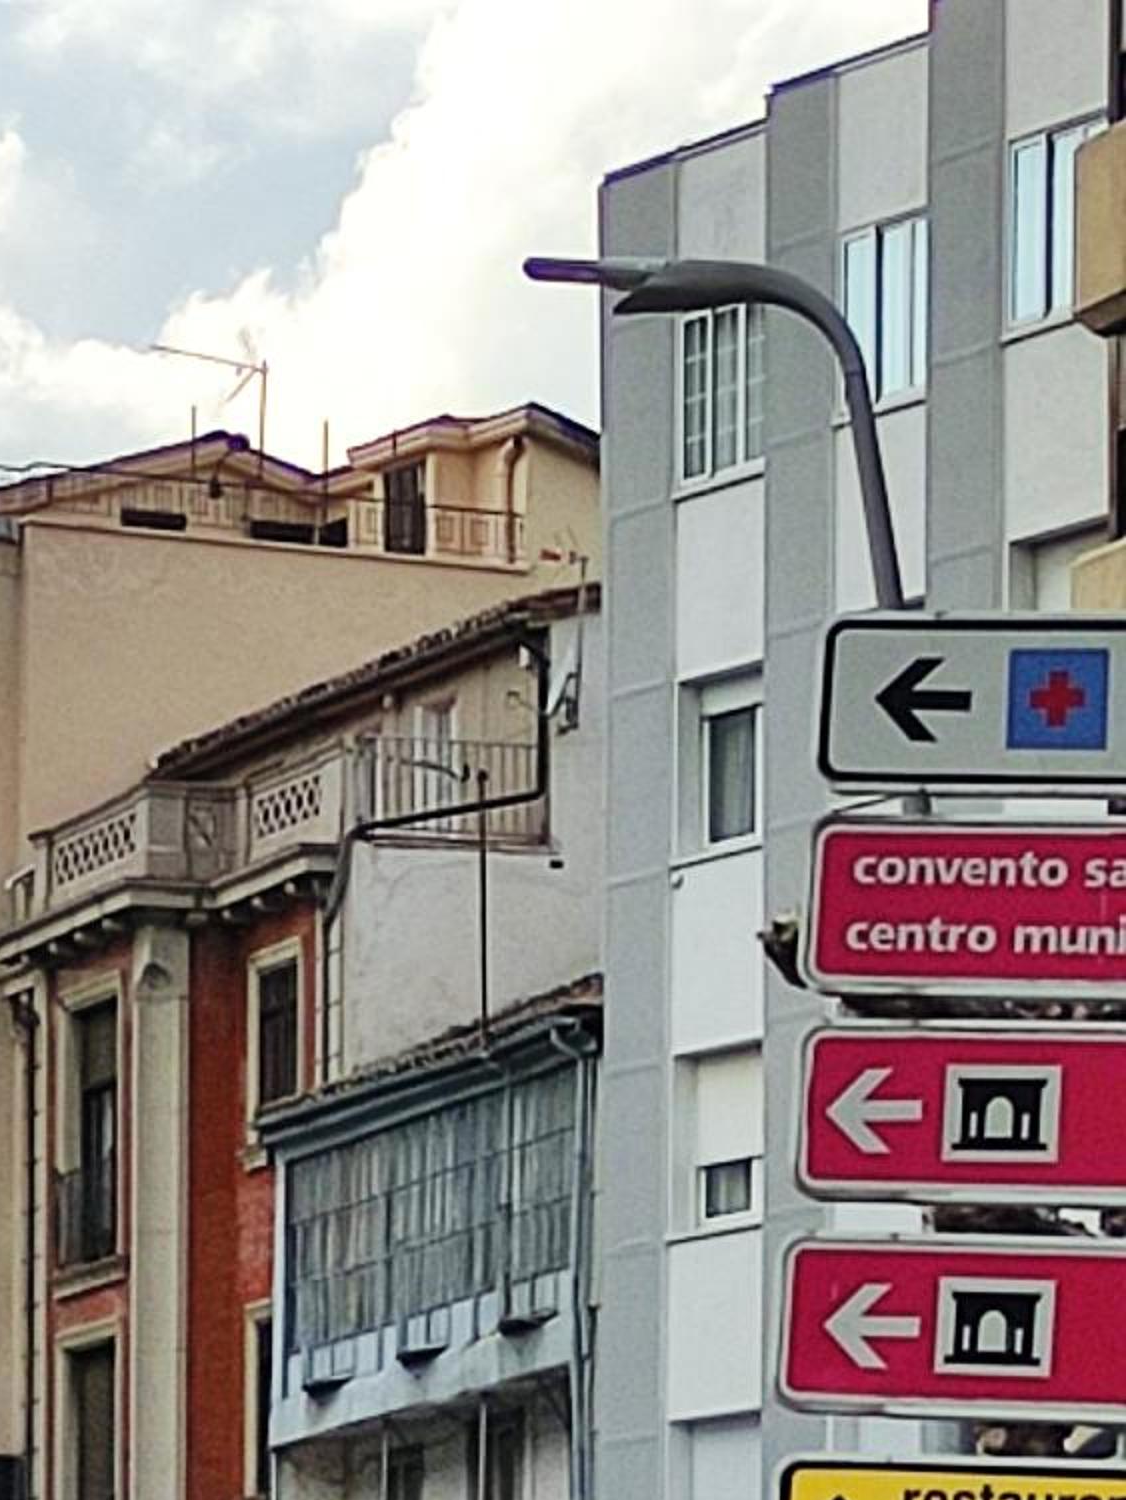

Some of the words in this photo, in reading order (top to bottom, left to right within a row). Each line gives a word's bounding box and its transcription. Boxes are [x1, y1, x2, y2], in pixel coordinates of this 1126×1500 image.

[853, 852, 1069, 887] convento
[1084, 857, 1126, 888] sa
[845, 916, 997, 952] centro
